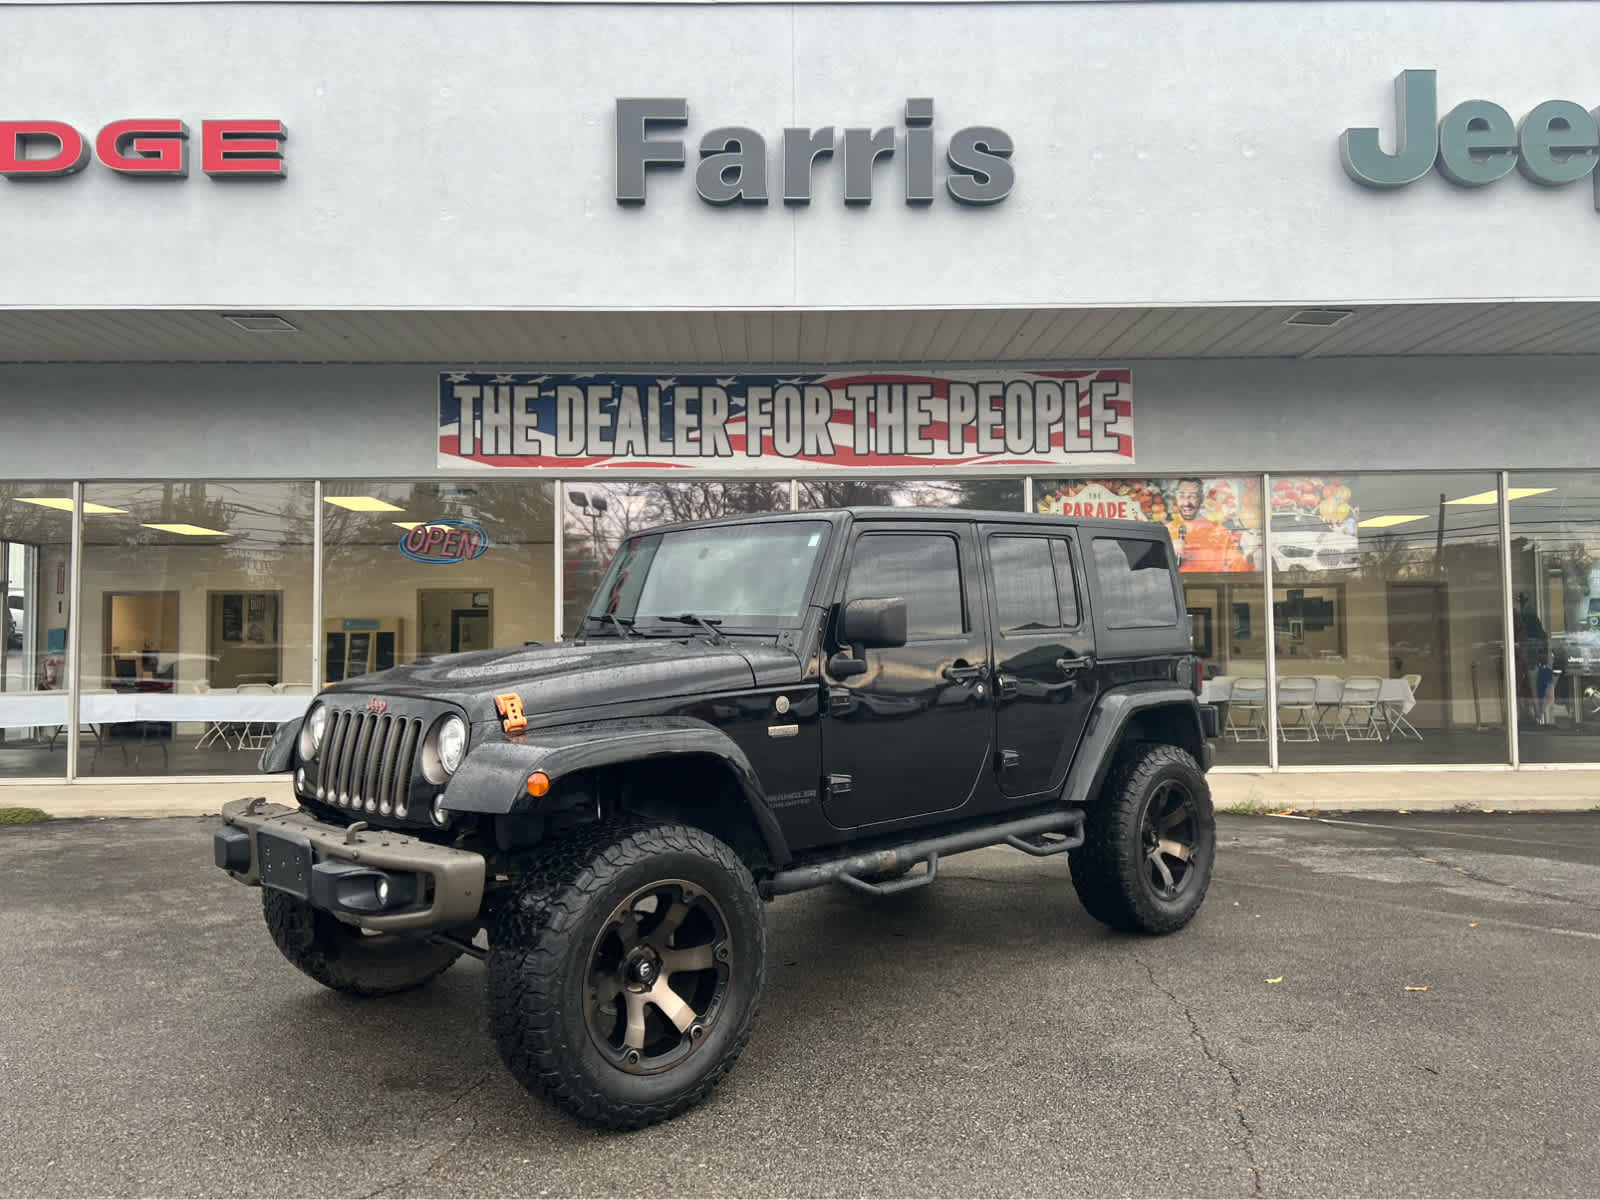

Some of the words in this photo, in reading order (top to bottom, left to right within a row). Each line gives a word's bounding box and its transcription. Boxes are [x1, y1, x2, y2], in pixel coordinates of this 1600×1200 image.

[615, 98, 1015, 206] Farris
[1339, 69, 1600, 212] Jee
[453, 384, 542, 457] THE
[554, 384, 734, 457] DEALER
[745, 383, 835, 457] FOR
[845, 383, 934, 456] THE
[947, 380, 1121, 454] PEOPLE
[407, 525, 479, 560] OPEN
[1063, 501, 1128, 518] PARADE
